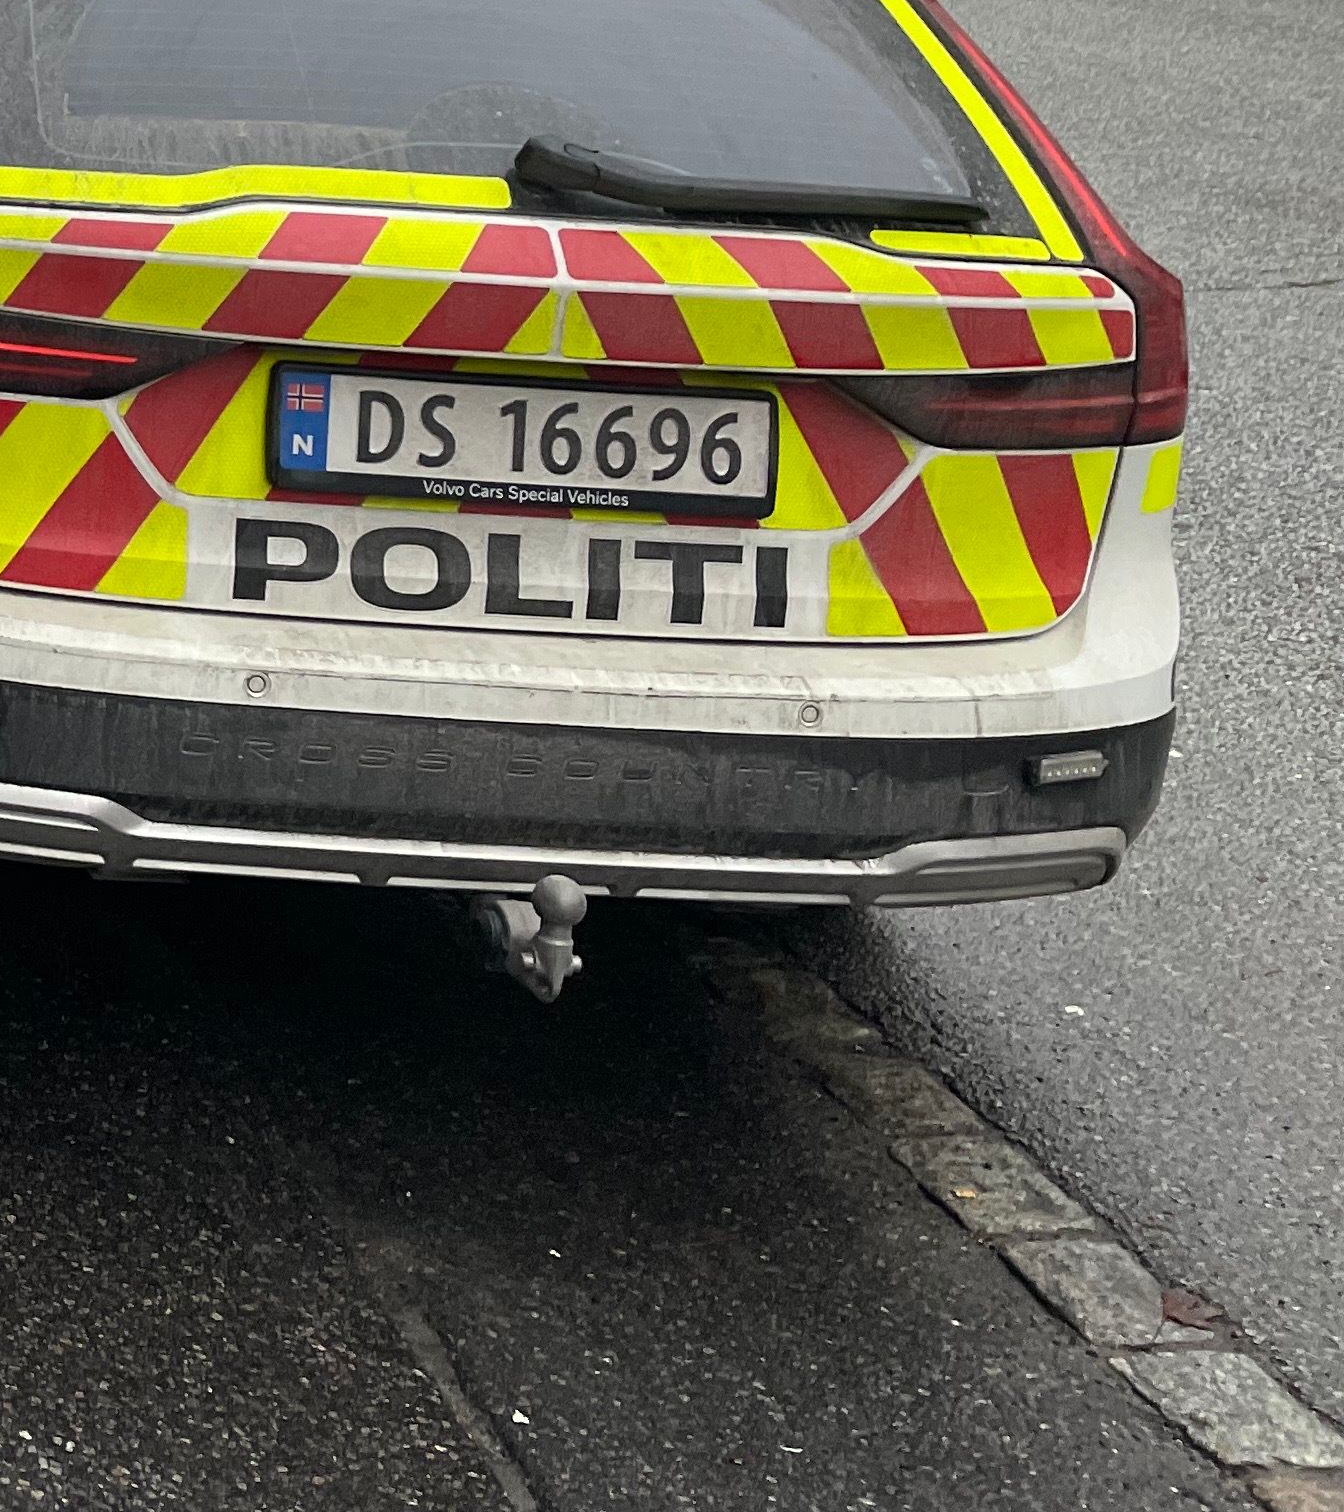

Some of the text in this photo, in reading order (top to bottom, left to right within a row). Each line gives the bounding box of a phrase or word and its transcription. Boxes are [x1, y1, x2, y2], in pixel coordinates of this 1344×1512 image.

[292, 433, 314, 456] N
[355, 390, 744, 485] DS 16696
[423, 479, 629, 508] Volvo Cars Special Vehicles
[231, 517, 789, 629] POLITI
[180, 733, 874, 792] CROSS COUNTR
